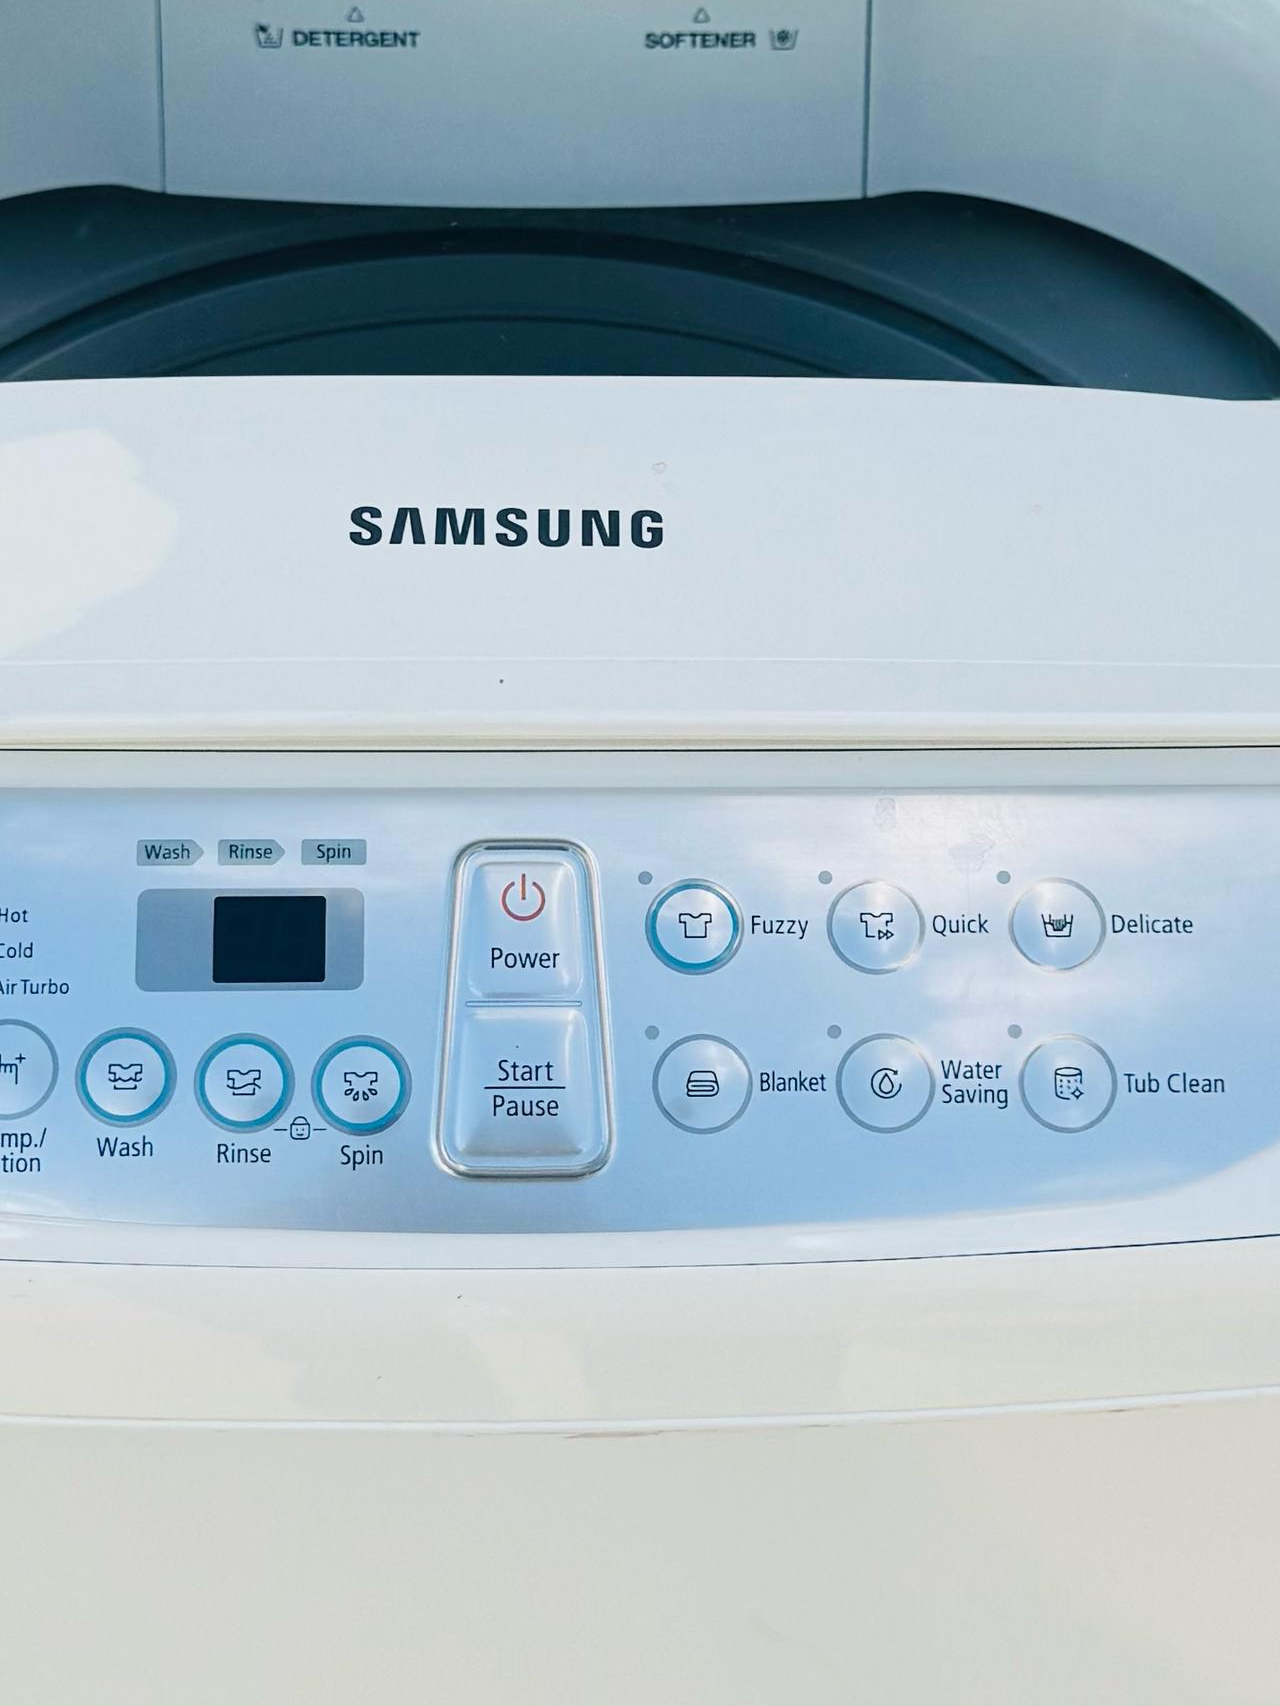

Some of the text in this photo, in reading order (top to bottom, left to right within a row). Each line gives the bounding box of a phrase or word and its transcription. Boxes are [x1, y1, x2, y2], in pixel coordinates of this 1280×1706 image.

[292, 29, 420, 48] DETERGENT
[644, 31, 756, 50] SOFTENER
[348, 505, 664, 549] SAMSUNG
[144, 842, 191, 860] Wash
[229, 843, 273, 860] Rinse
[316, 843, 352, 864] Spin
[751, 914, 809, 940] Fuzzy
[932, 913, 990, 938] Quick
[1111, 913, 1194, 934] Delicate
[491, 947, 560, 969] Power
[23, 977, 70, 995] Turbo
[498, 1059, 554, 1082] Start
[940, 1059, 1003, 1080] Water
[759, 1070, 827, 1093] Blanket
[1123, 1071, 1225, 1094] Tub Clean
[493, 1094, 559, 1117] Pause
[941, 1083, 1009, 1110] Saving
[96, 1134, 154, 1157] Wash
[217, 1142, 272, 1164] Rinse
[340, 1143, 384, 1172] Spin
